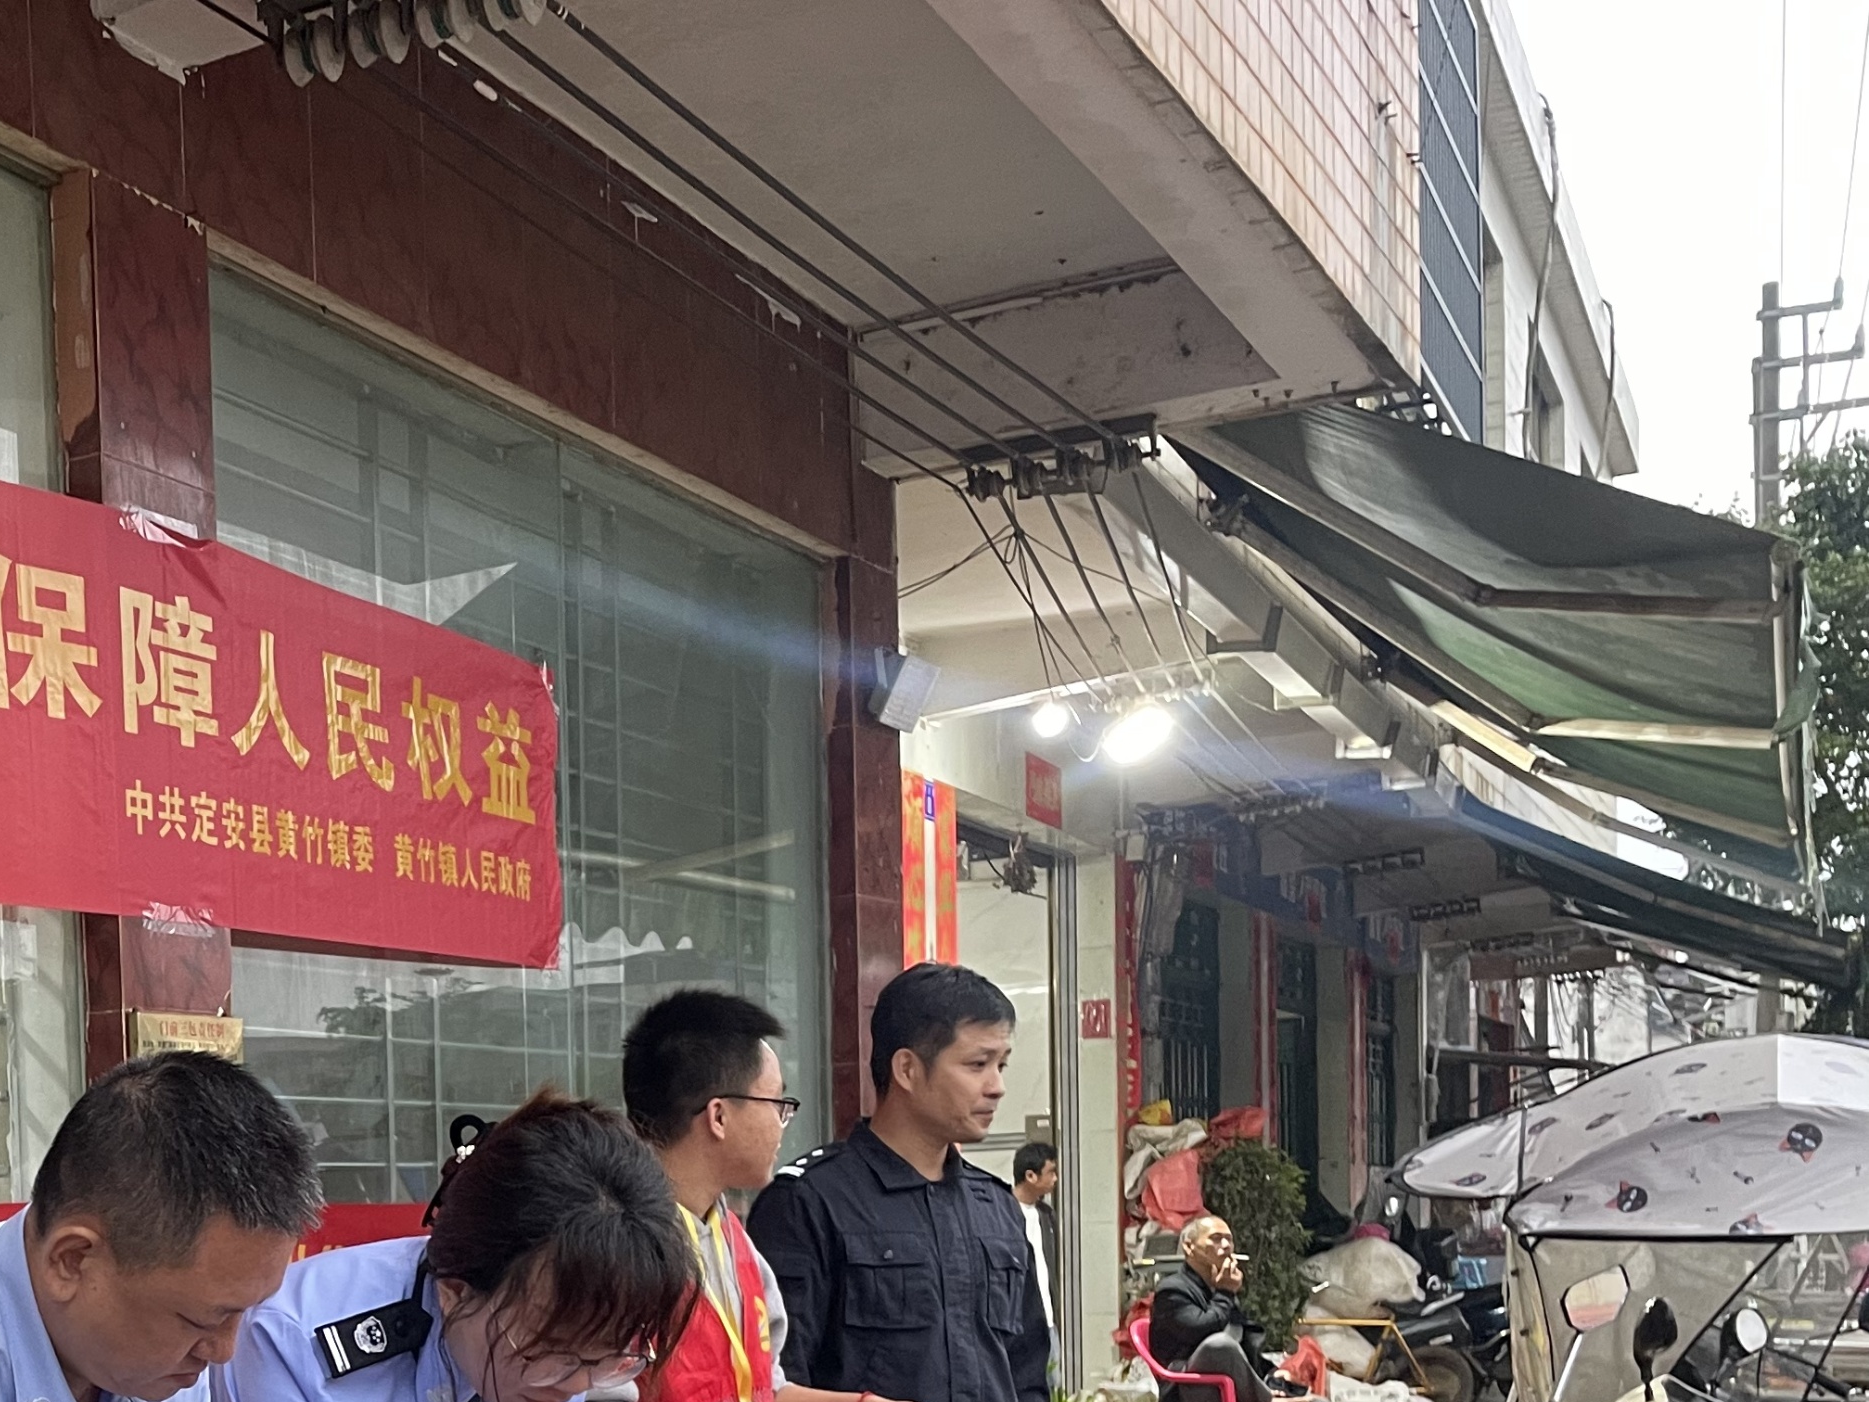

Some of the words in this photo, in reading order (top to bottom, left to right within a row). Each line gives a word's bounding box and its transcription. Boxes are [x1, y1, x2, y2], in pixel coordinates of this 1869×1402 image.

[124, 779, 375, 873] 中共定安县黄竹镇委
[394, 833, 532, 901] 黄竹镇人民政府
